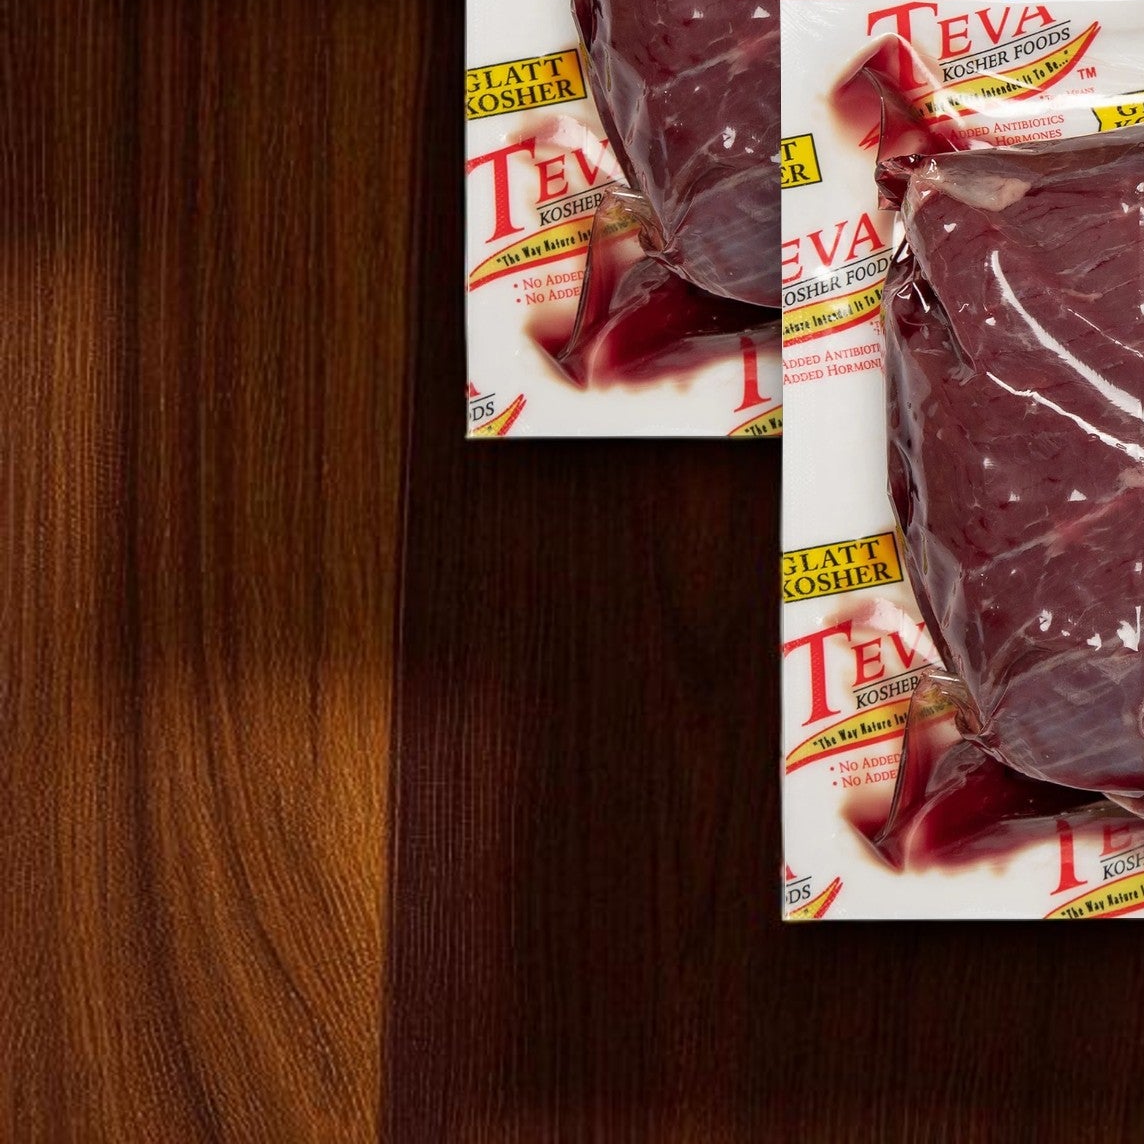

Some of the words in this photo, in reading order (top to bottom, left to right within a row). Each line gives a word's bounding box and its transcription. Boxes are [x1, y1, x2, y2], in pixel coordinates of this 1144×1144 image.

[942, 52, 1010, 83] KOSHER
[1014, 27, 1071, 60] FOODS
[1033, 68, 1046, 80] To
[1077, 66, 1098, 80] TM
[994, 115, 1065, 133] ANTIBIOTICS
[540, 193, 603, 226] KOSHER
[856, 676, 919, 709] KOSHER
[838, 725, 858, 742] Way
[859, 716, 892, 735] Nature
[1106, 890, 1139, 906] Nature
